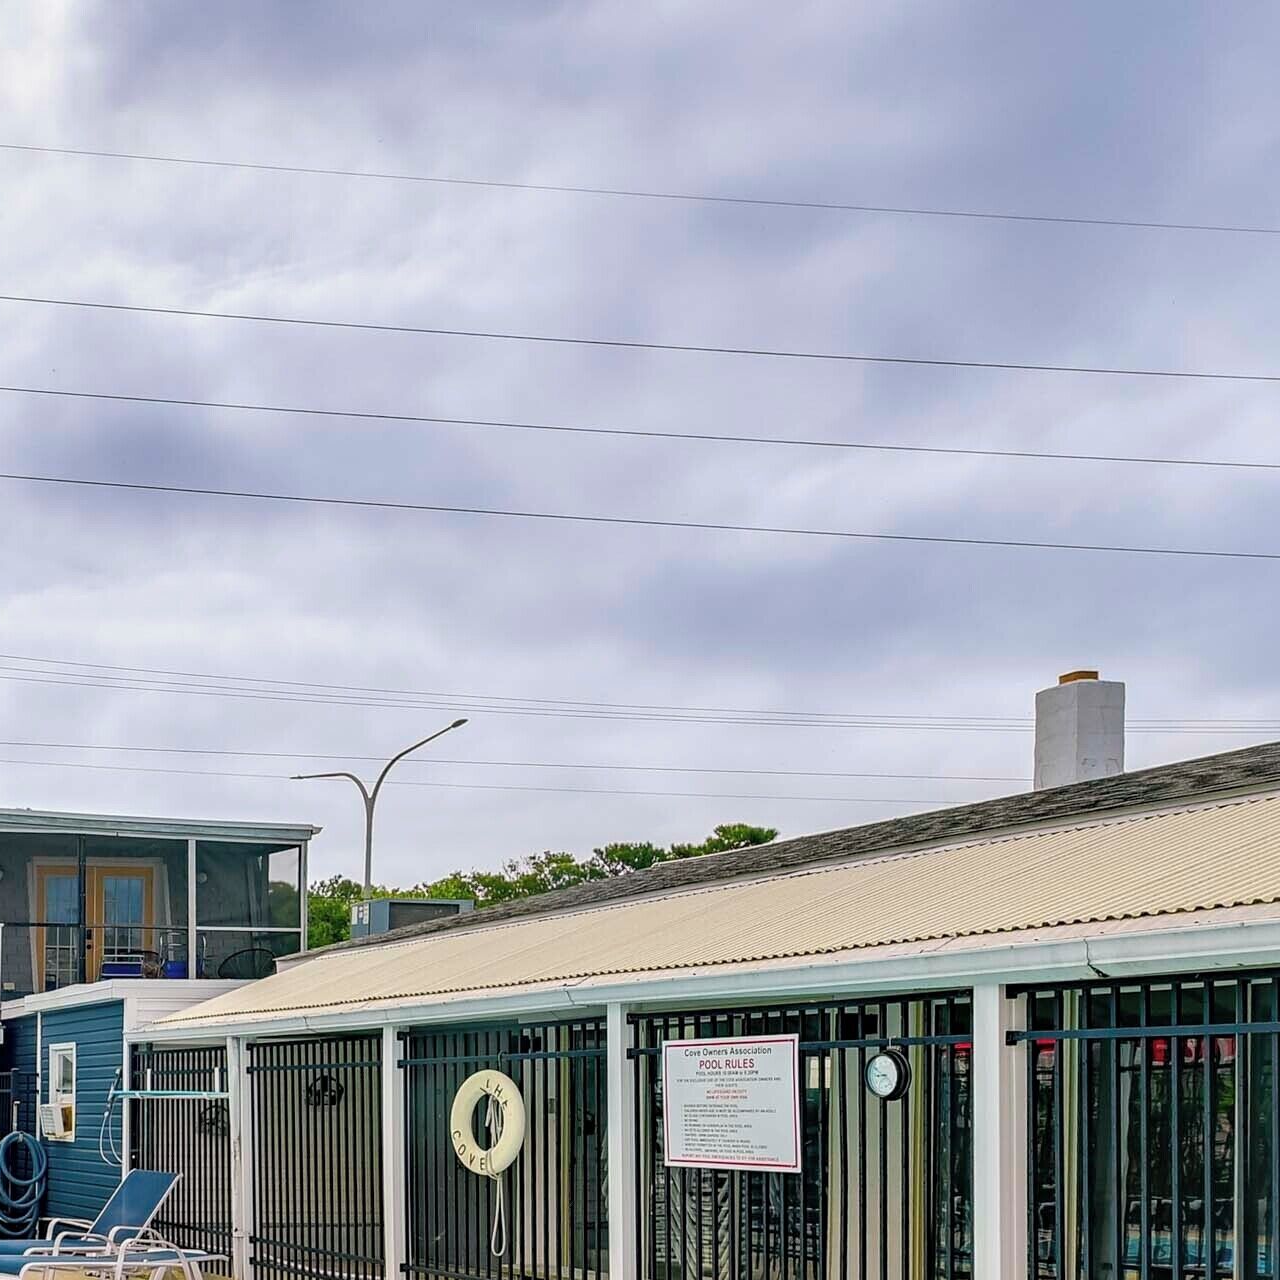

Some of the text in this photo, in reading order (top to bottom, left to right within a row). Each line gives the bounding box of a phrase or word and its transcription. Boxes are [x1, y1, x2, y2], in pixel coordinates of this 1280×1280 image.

[684, 1046, 772, 1057] Cove Owners Association
[699, 1058, 755, 1070] POOL RULES
[452, 1130, 486, 1171] COVE
